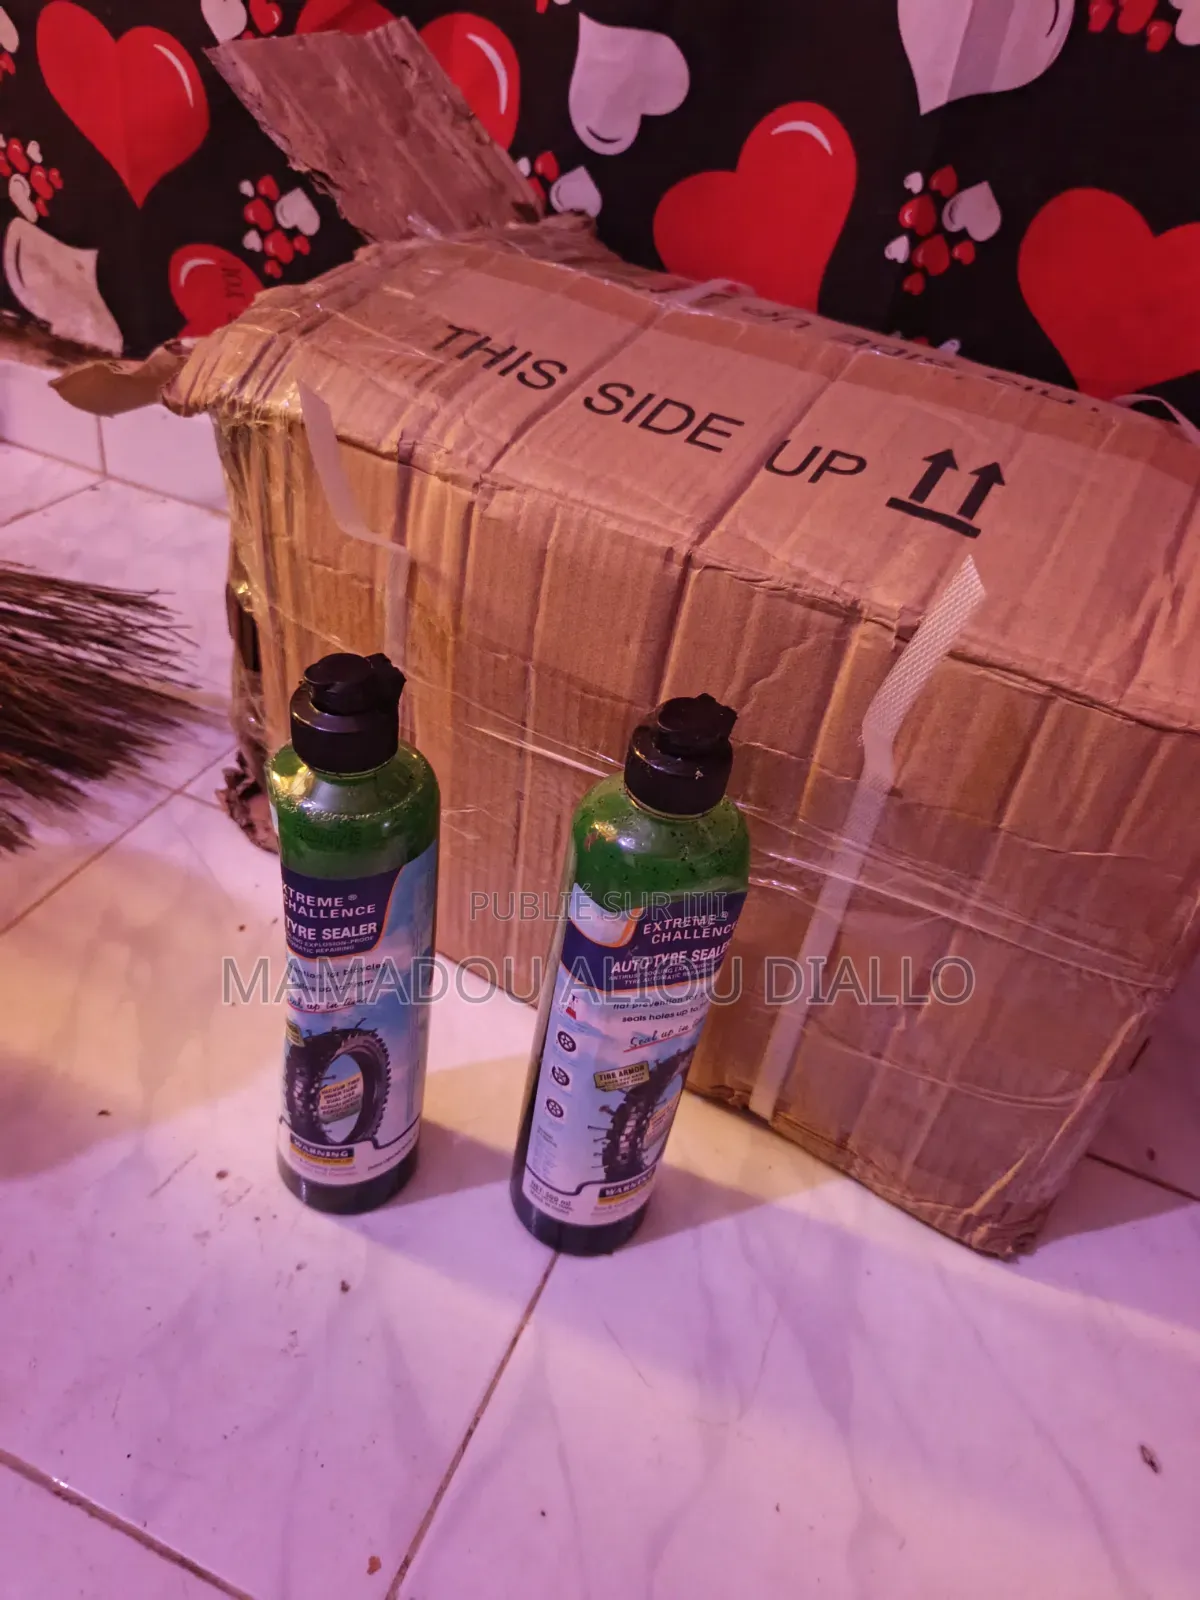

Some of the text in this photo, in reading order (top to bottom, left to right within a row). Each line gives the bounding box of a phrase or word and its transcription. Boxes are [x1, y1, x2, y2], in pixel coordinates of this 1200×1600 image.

[429, 324, 868, 484] THIS SIDE UP
[321, 922, 378, 941] SEALER
[643, 914, 717, 935] EXTREME
[611, 956, 650, 974] AUTO
[653, 950, 688, 968] TYRE
[622, 1014, 647, 1022] seals
[648, 1010, 675, 1021] holes
[676, 1009, 689, 1018] up
[629, 1029, 659, 1048] Seal
[599, 1071, 617, 1081] TIRE
[618, 1064, 646, 1077] ARMOR
[294, 1138, 349, 1158] WARNING
